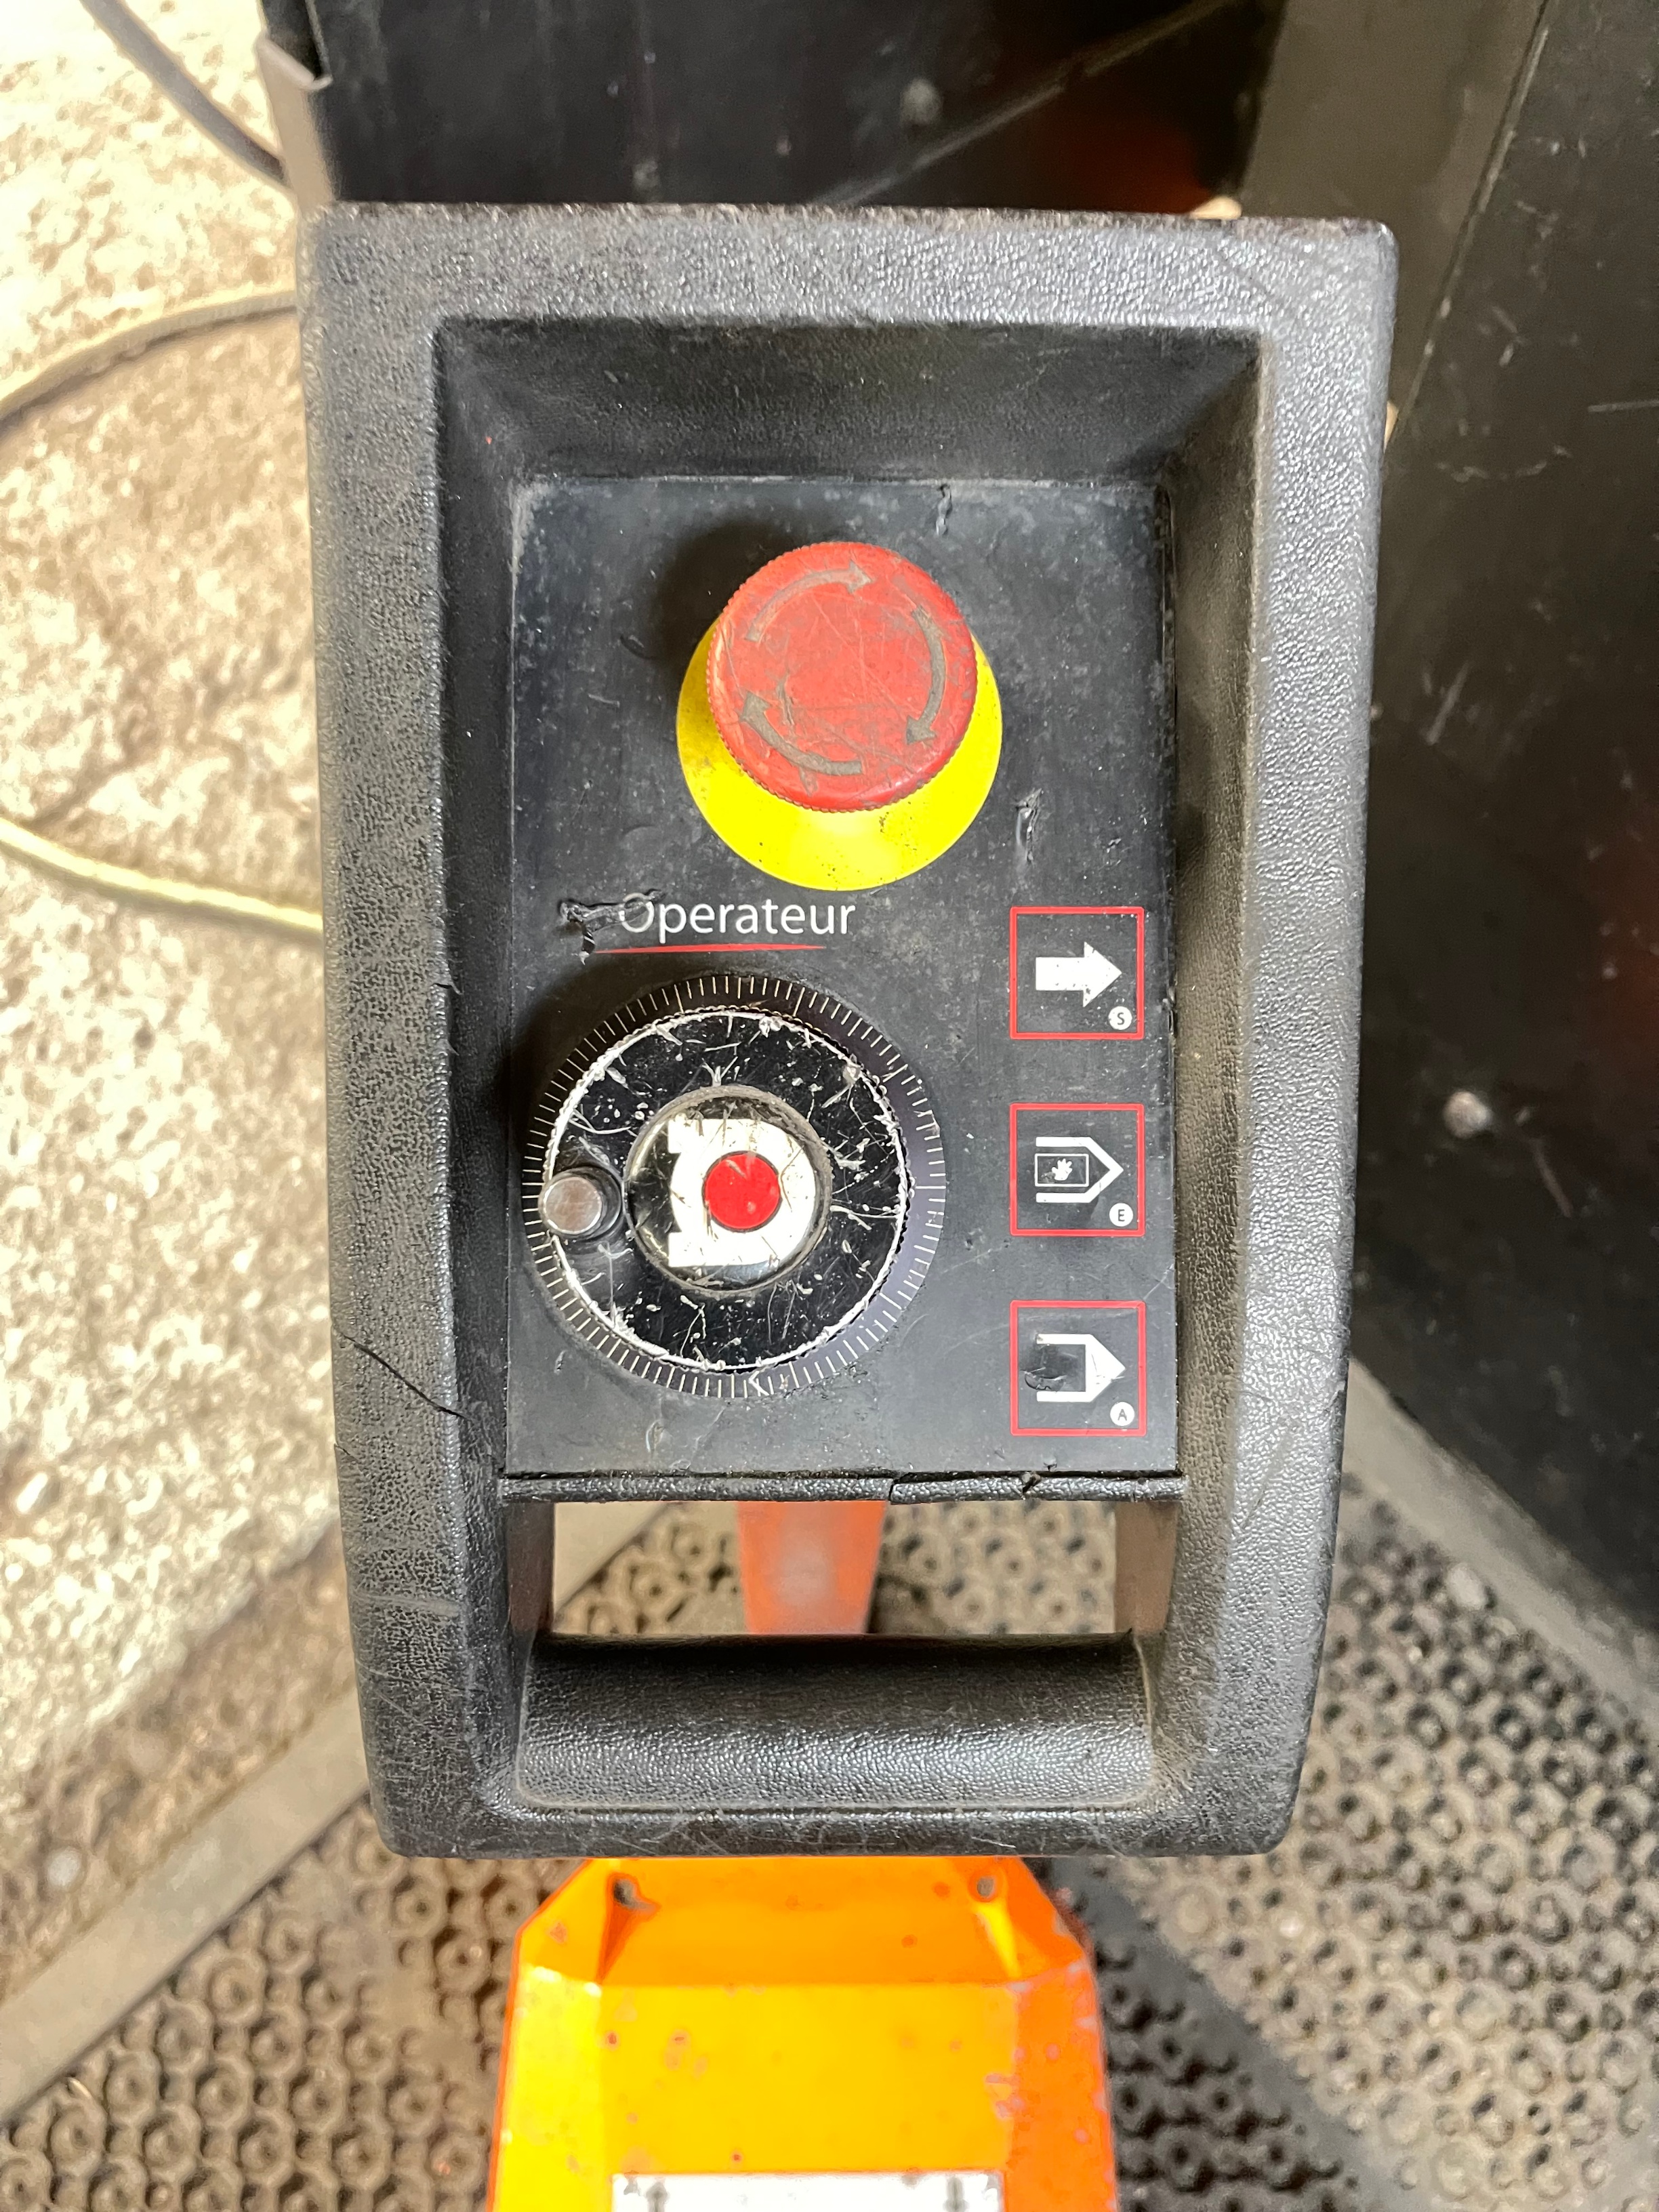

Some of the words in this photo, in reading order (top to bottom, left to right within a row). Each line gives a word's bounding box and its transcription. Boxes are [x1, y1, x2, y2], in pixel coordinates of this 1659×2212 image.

[619, 892, 857, 944] Operateur
[1116, 1012, 1125, 1025] S
[1118, 1209, 1126, 1222] E
[1118, 1408, 1128, 1422] A
